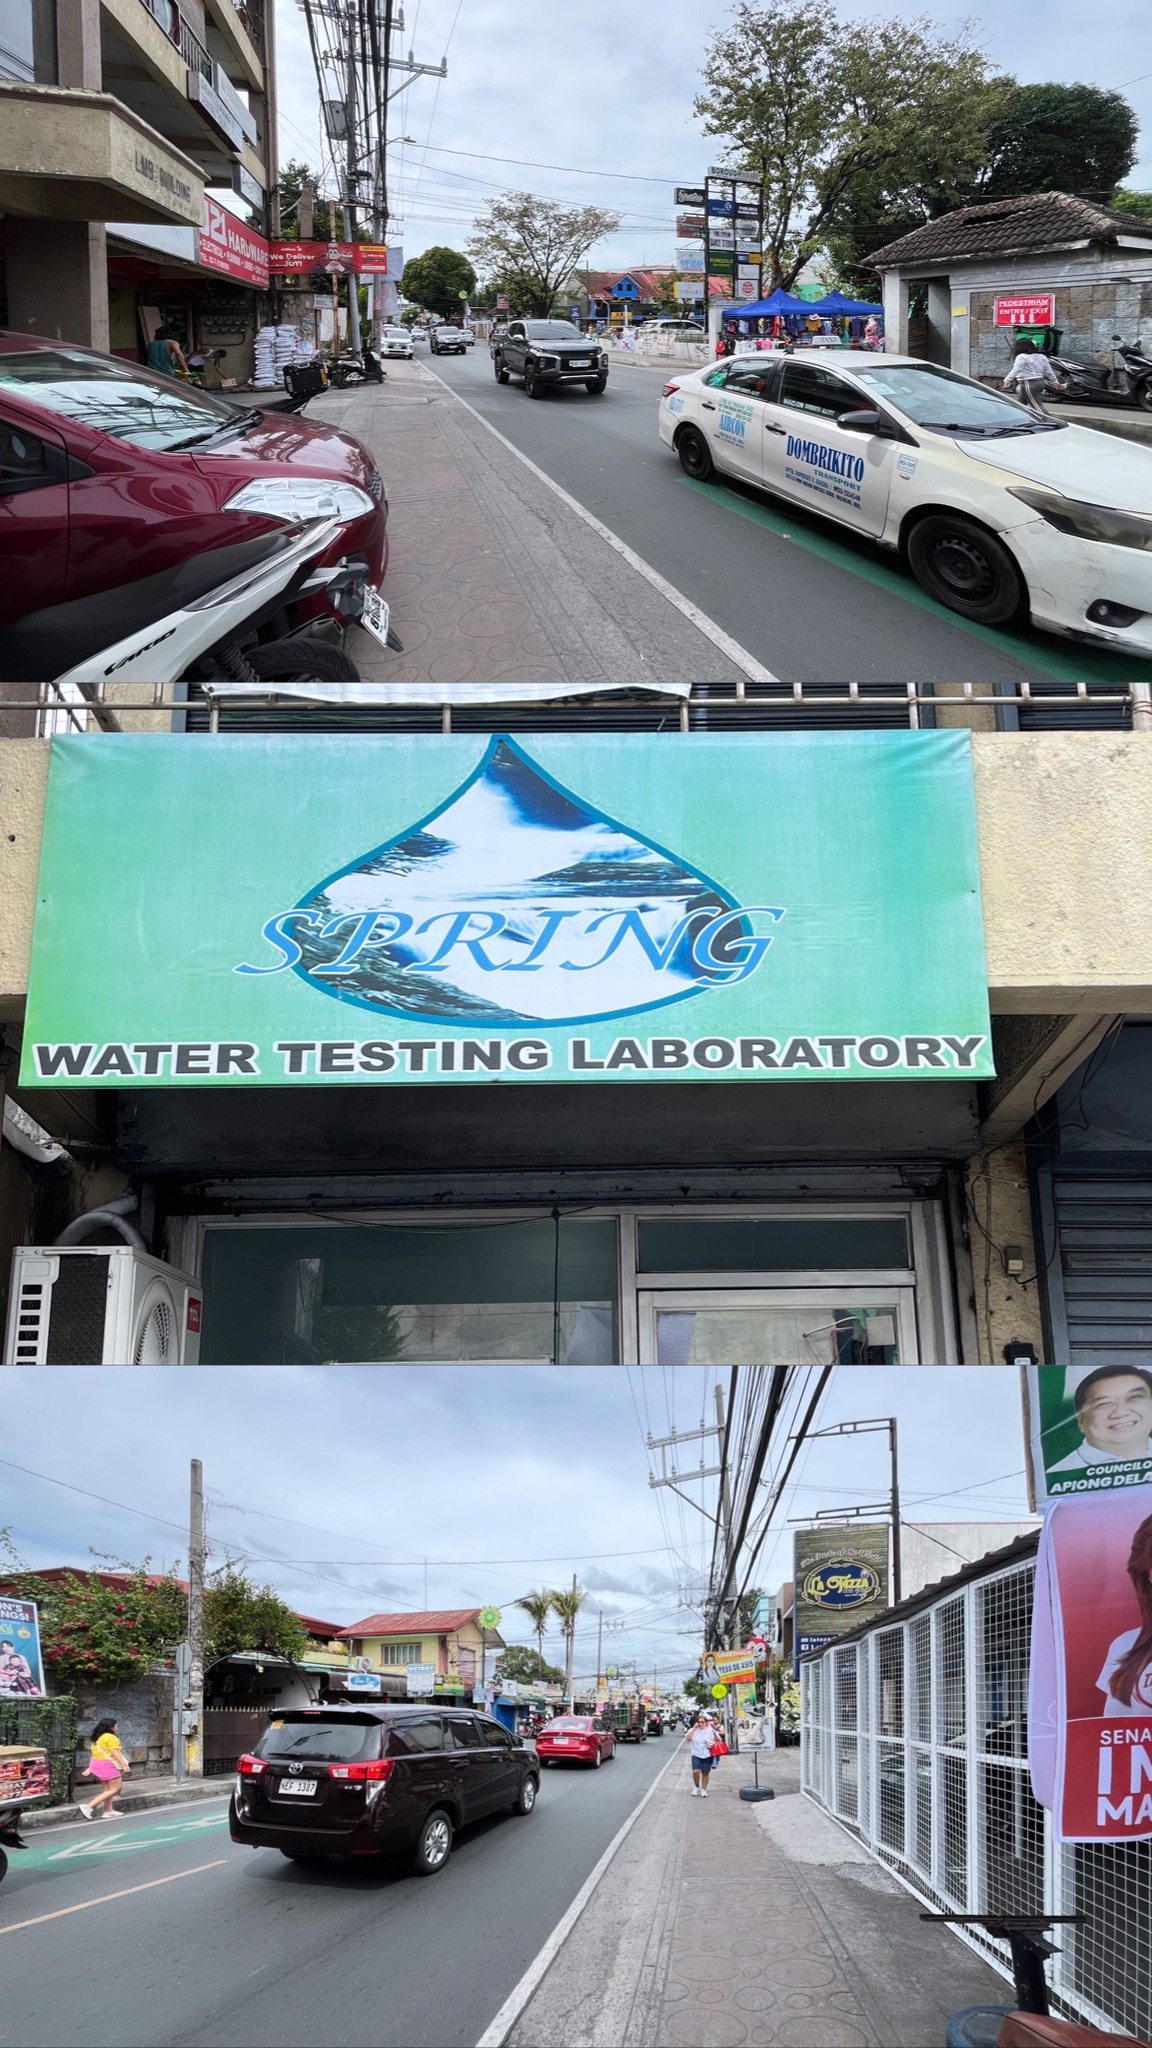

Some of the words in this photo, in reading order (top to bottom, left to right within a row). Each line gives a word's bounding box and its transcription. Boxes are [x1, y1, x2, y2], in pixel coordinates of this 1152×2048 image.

[711, 166, 741, 177] BOROUGH
[228, 229, 269, 268] HARDWARE
[270, 253, 284, 261] We
[285, 252, 315, 260] Deliver
[999, 298, 1049, 307] PEDESTRIAN
[719, 413, 747, 438] AIRCON
[786, 434, 865, 482] DOMBRIKITO
[812, 468, 862, 492] TRANSPORT
[234, 906, 786, 988] SPRING
[35, 1043, 258, 1076] WATER
[277, 1039, 550, 1073] TESTING
[571, 1036, 985, 1070] LABORATORY
[1086, 1460, 1152, 1476] COUNCILO
[1049, 1476, 1113, 1494] APIONG
[718, 1665, 733, 1674] TESS
[733, 1663, 742, 1672] DE
[741, 1660, 754, 1669] ASIS
[1100, 1728, 1152, 1745] SENA
[281, 1780, 294, 1792] NEF
